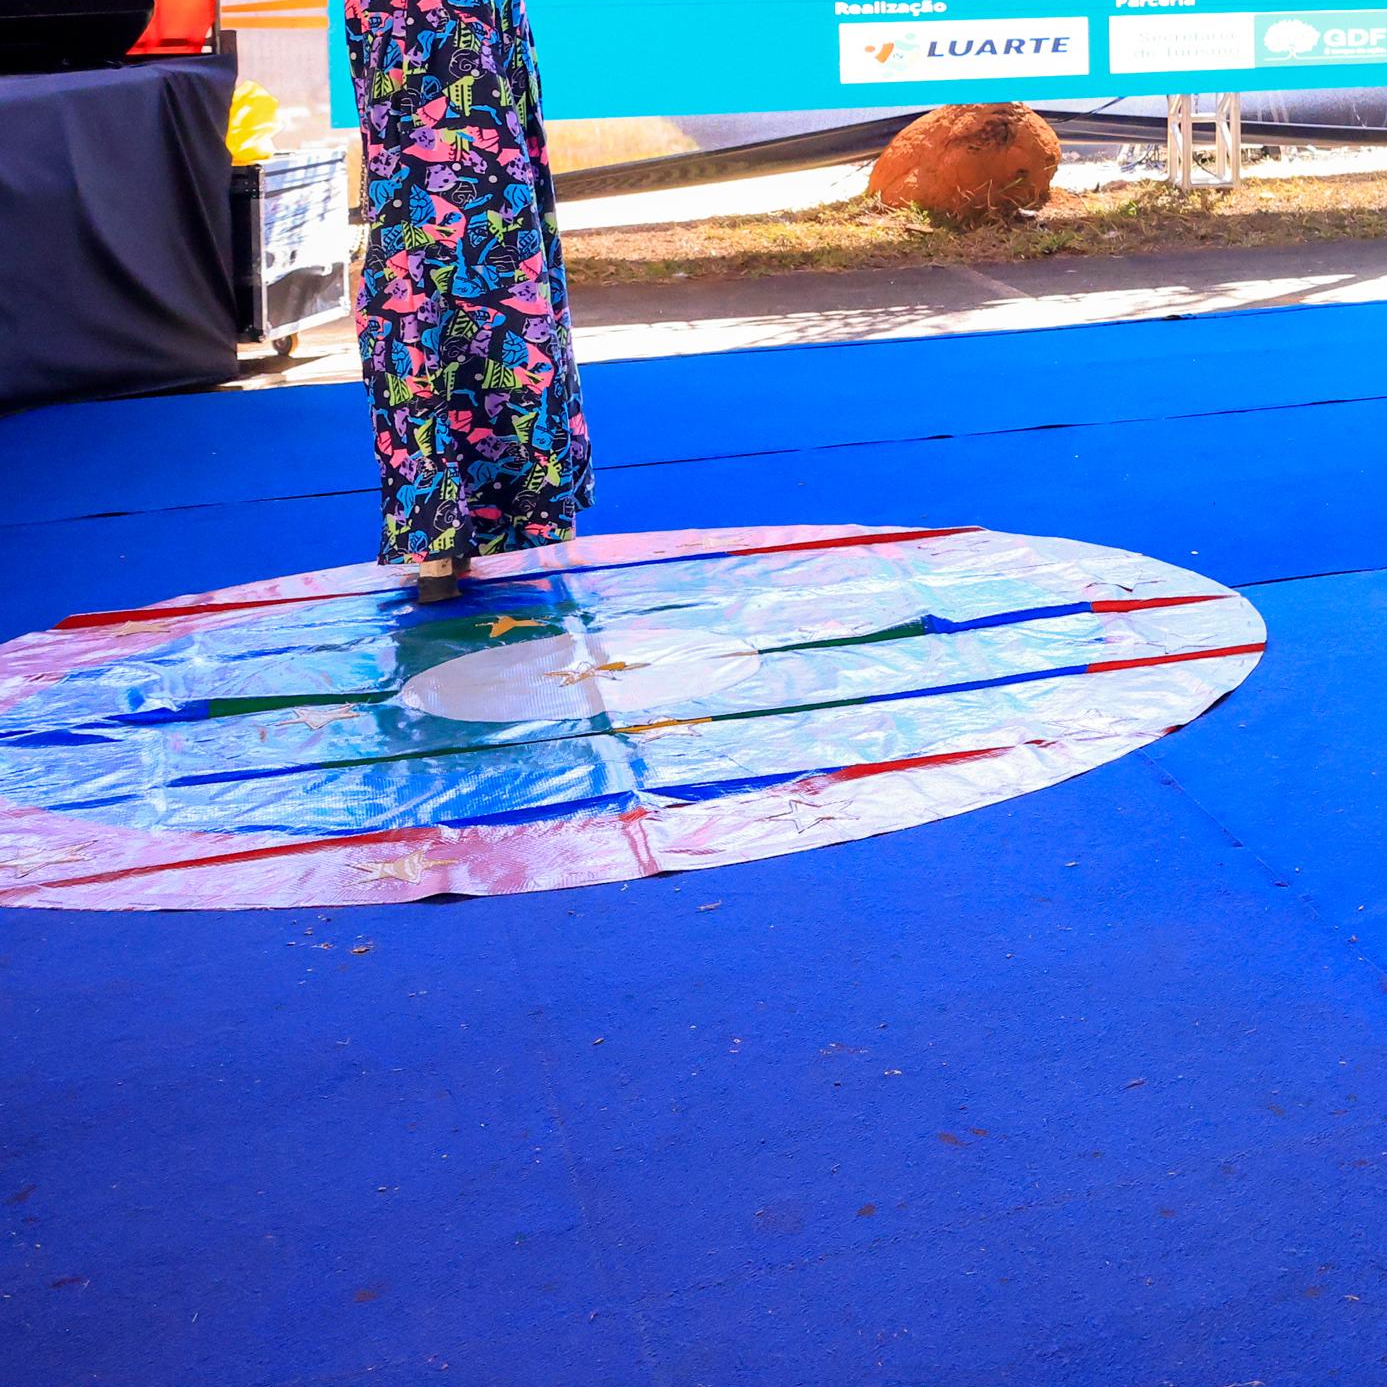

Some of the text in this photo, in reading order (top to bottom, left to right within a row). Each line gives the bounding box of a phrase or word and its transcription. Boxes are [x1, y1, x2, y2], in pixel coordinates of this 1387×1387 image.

[835, 0, 947, 16] Realização
[1324, 28, 1387, 47] GDF
[927, 37, 1070, 58] LUARTE
